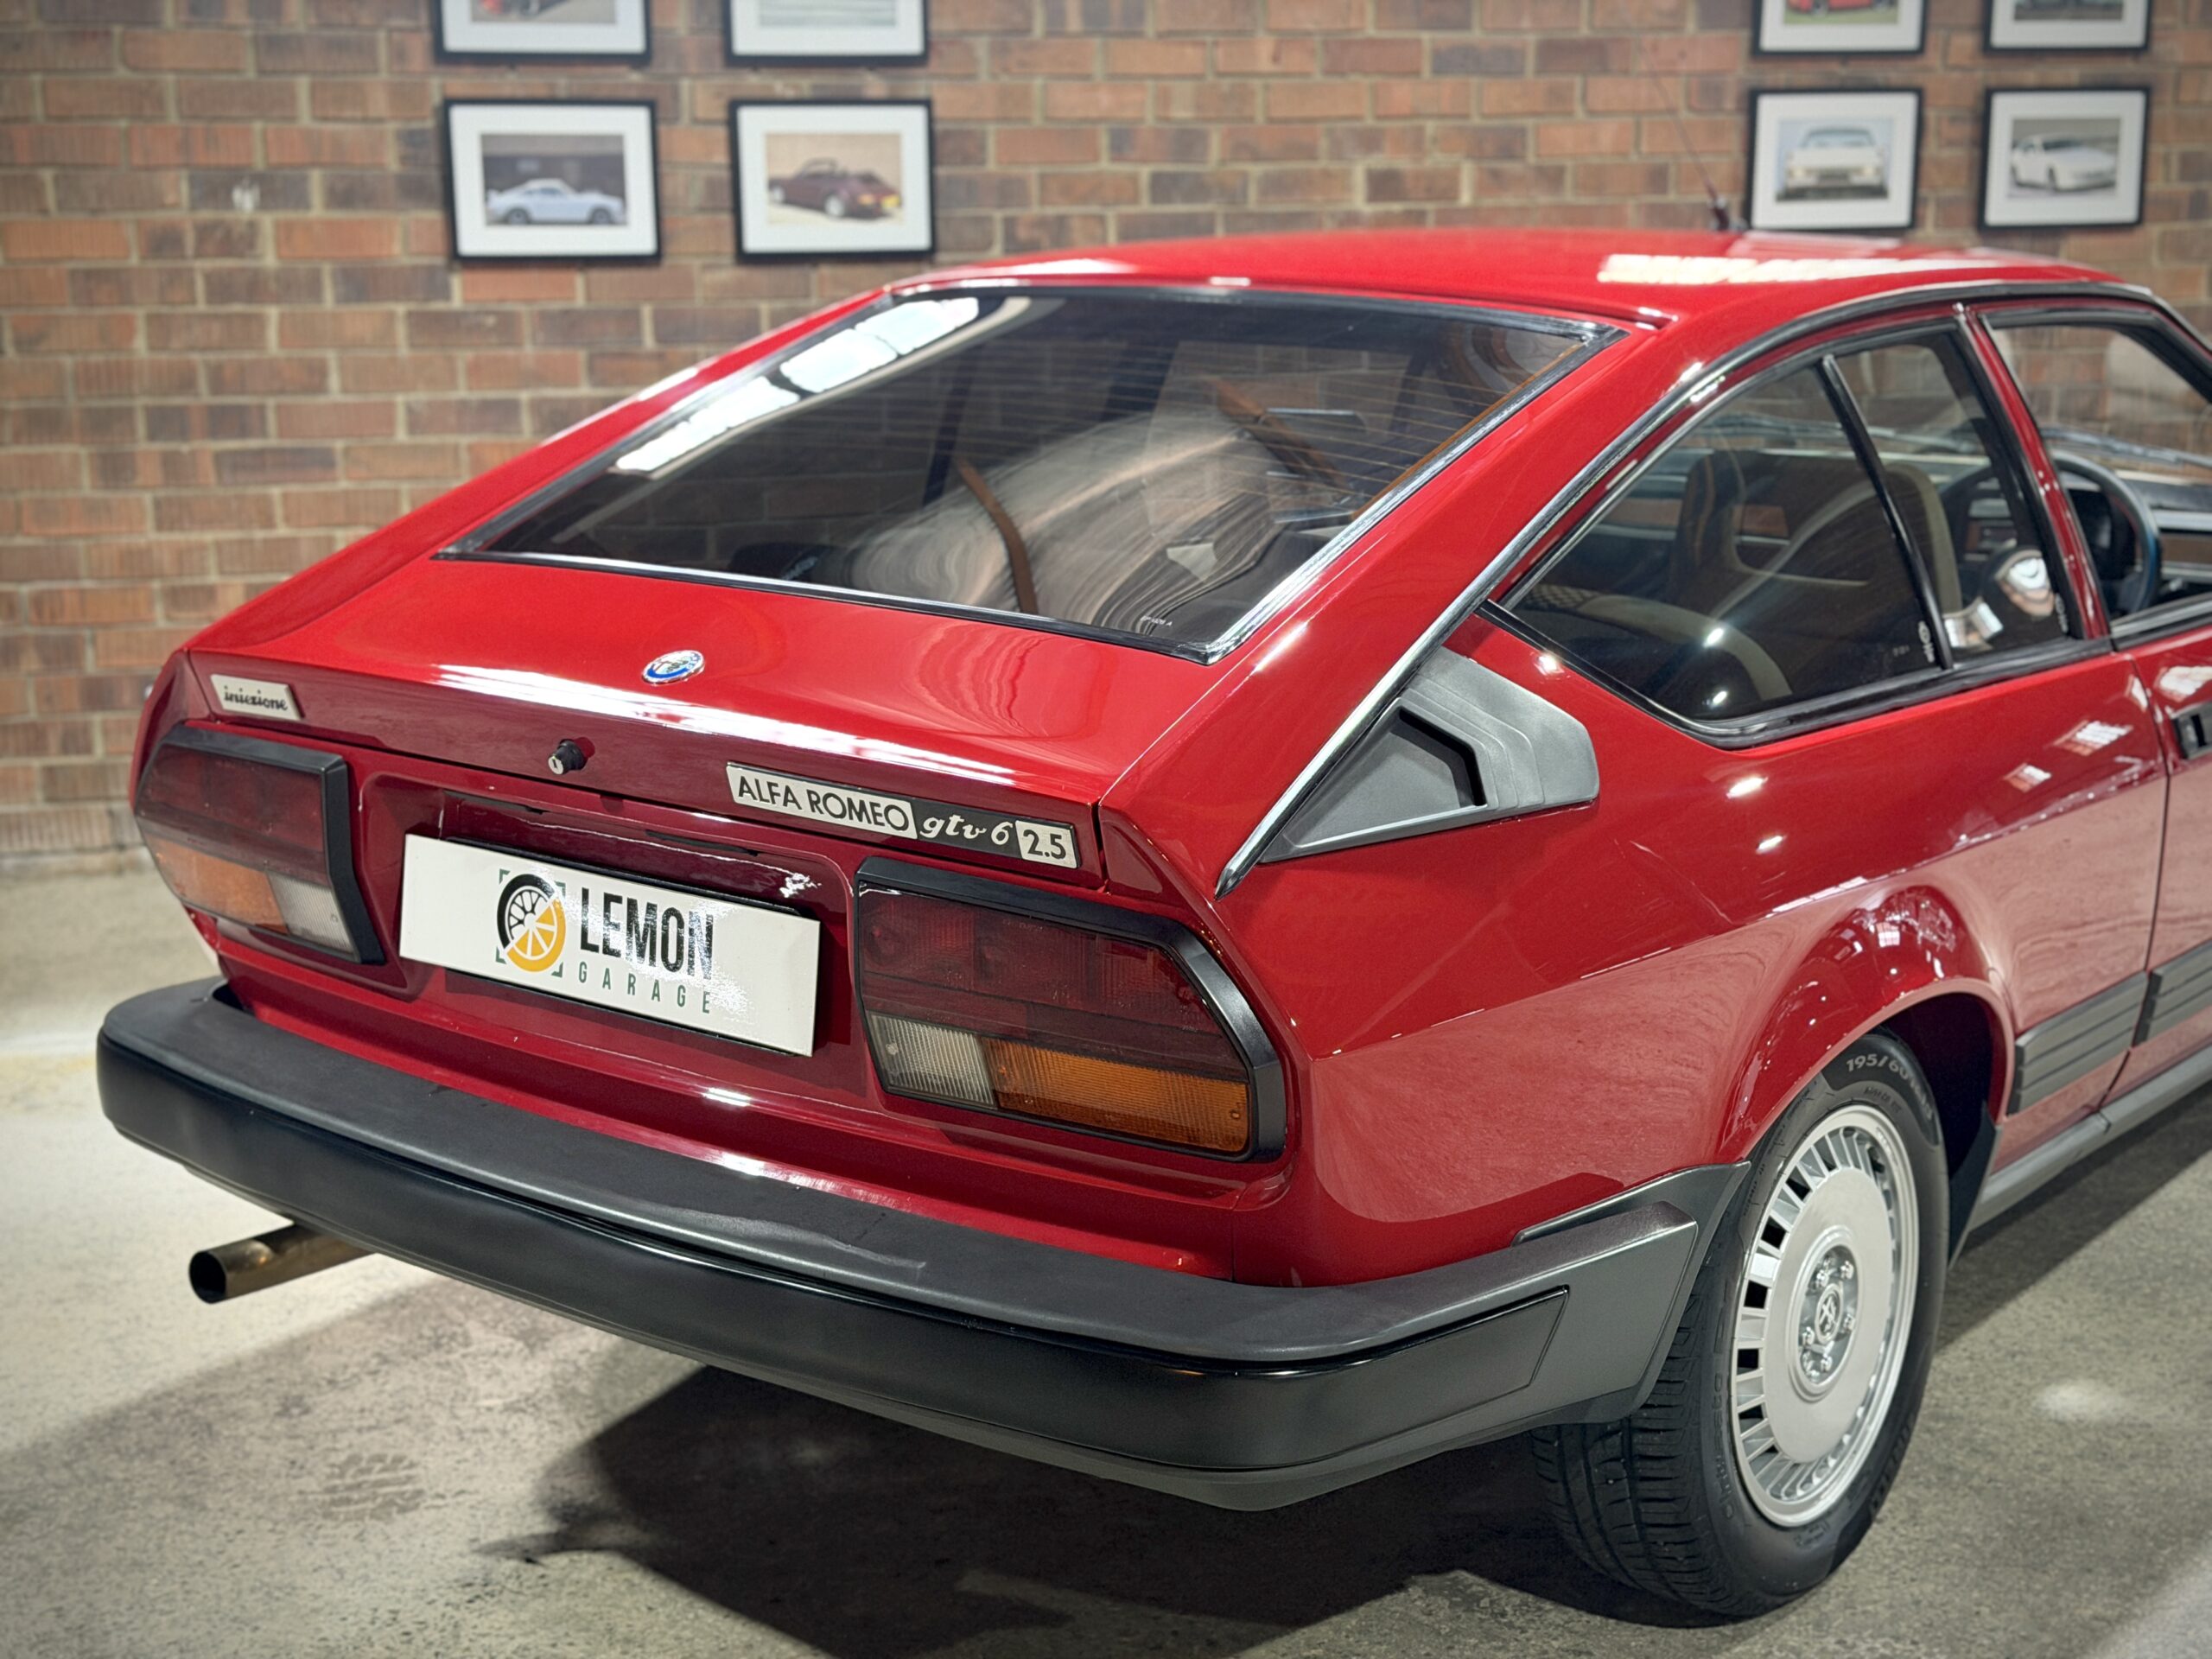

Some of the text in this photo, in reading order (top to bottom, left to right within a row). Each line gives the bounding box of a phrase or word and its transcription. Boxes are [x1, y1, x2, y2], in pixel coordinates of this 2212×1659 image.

[224, 685, 288, 710] iniezione
[738, 775, 803, 810] ALFA
[806, 789, 909, 831] ROMEO
[1023, 829, 1066, 860] 2.5
[581, 887, 714, 981] LEMON
[578, 961, 710, 1014] GARAGE
